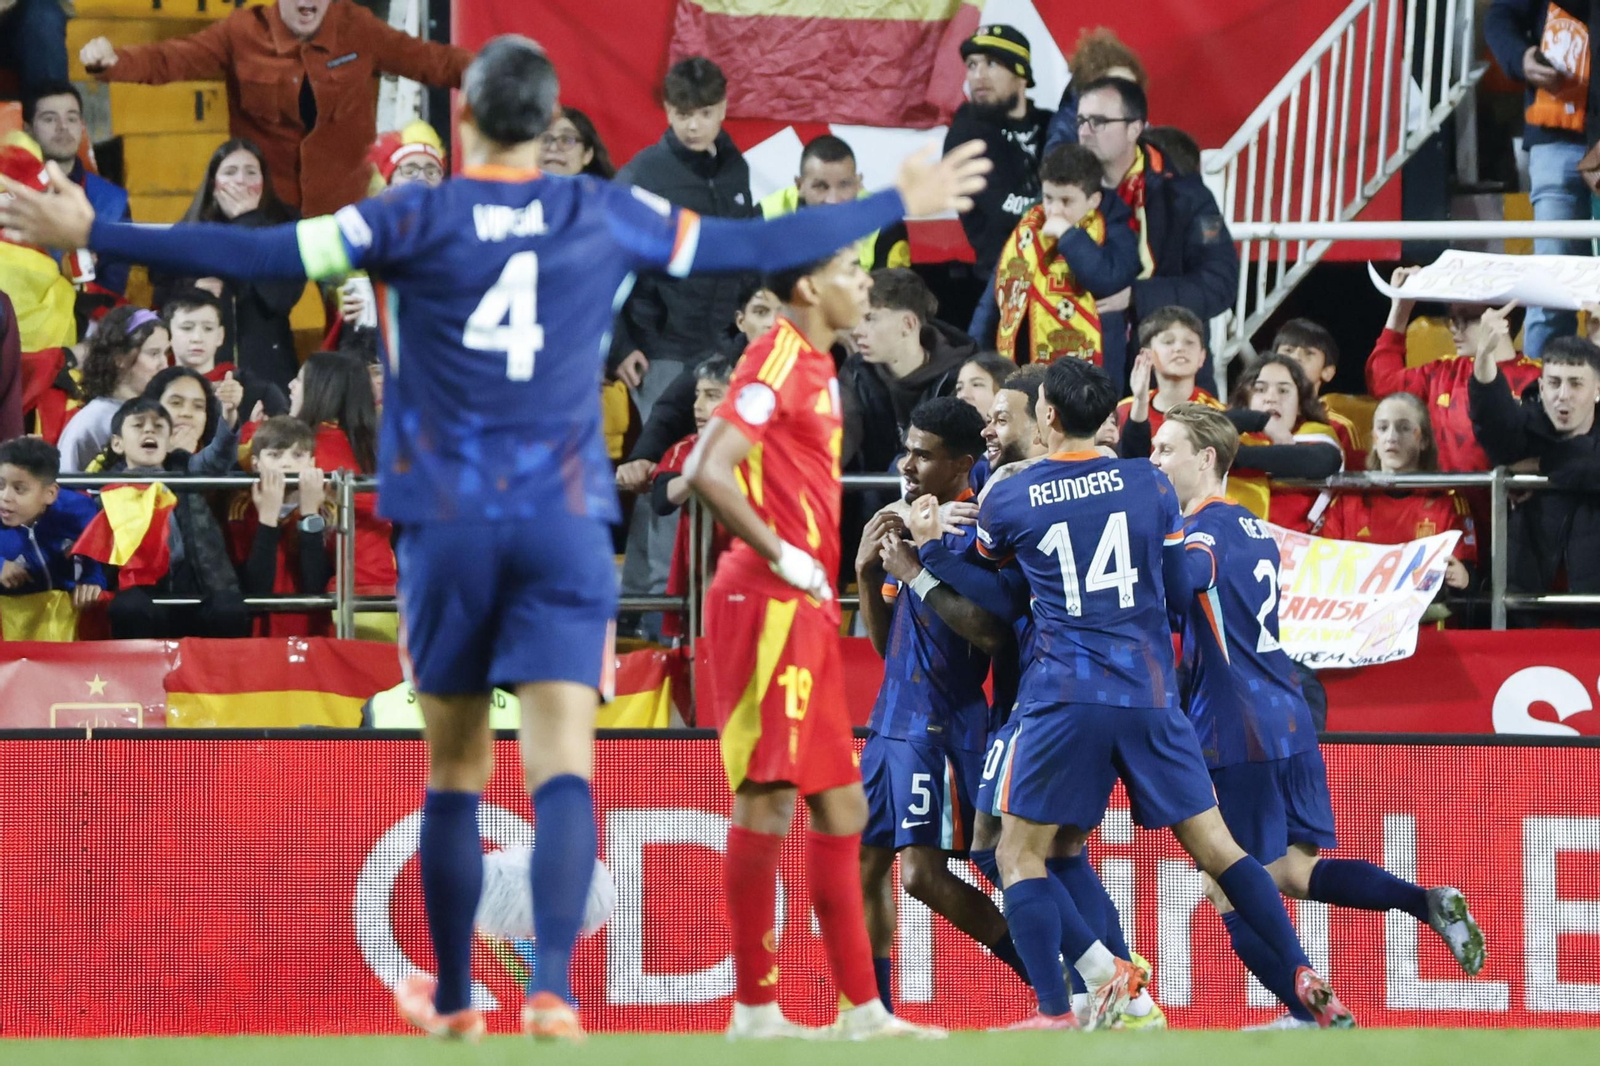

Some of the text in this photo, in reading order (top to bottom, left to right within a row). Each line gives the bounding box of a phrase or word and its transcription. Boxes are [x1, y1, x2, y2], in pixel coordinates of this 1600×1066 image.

[461, 250, 545, 382] 4
[1028, 468, 1124, 507] REIJNDERS
[1036, 511, 1139, 617] 14
[777, 664, 813, 721] 19
[982, 738, 1005, 781] 0
[908, 772, 931, 816] 5
